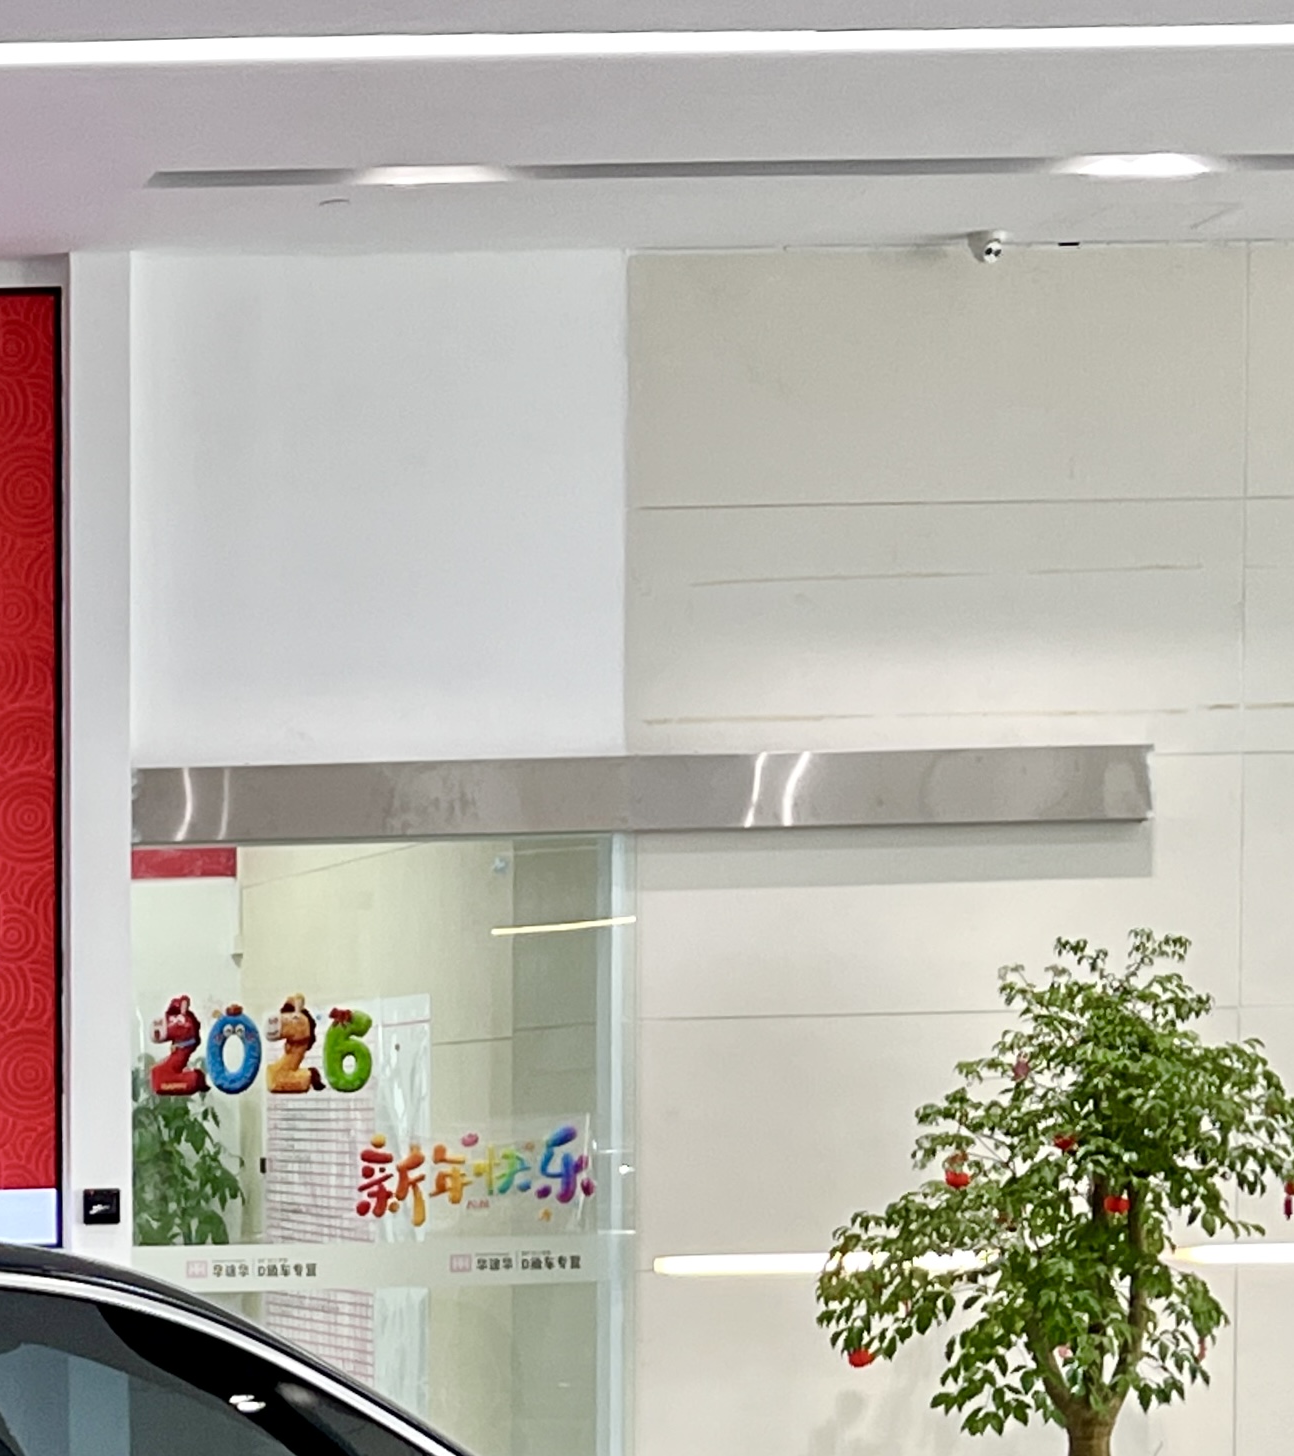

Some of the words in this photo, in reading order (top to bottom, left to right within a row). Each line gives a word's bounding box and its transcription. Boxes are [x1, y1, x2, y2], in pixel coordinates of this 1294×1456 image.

[150, 993, 373, 1095] 2026
[356, 1126, 595, 1226] 新年快乐
